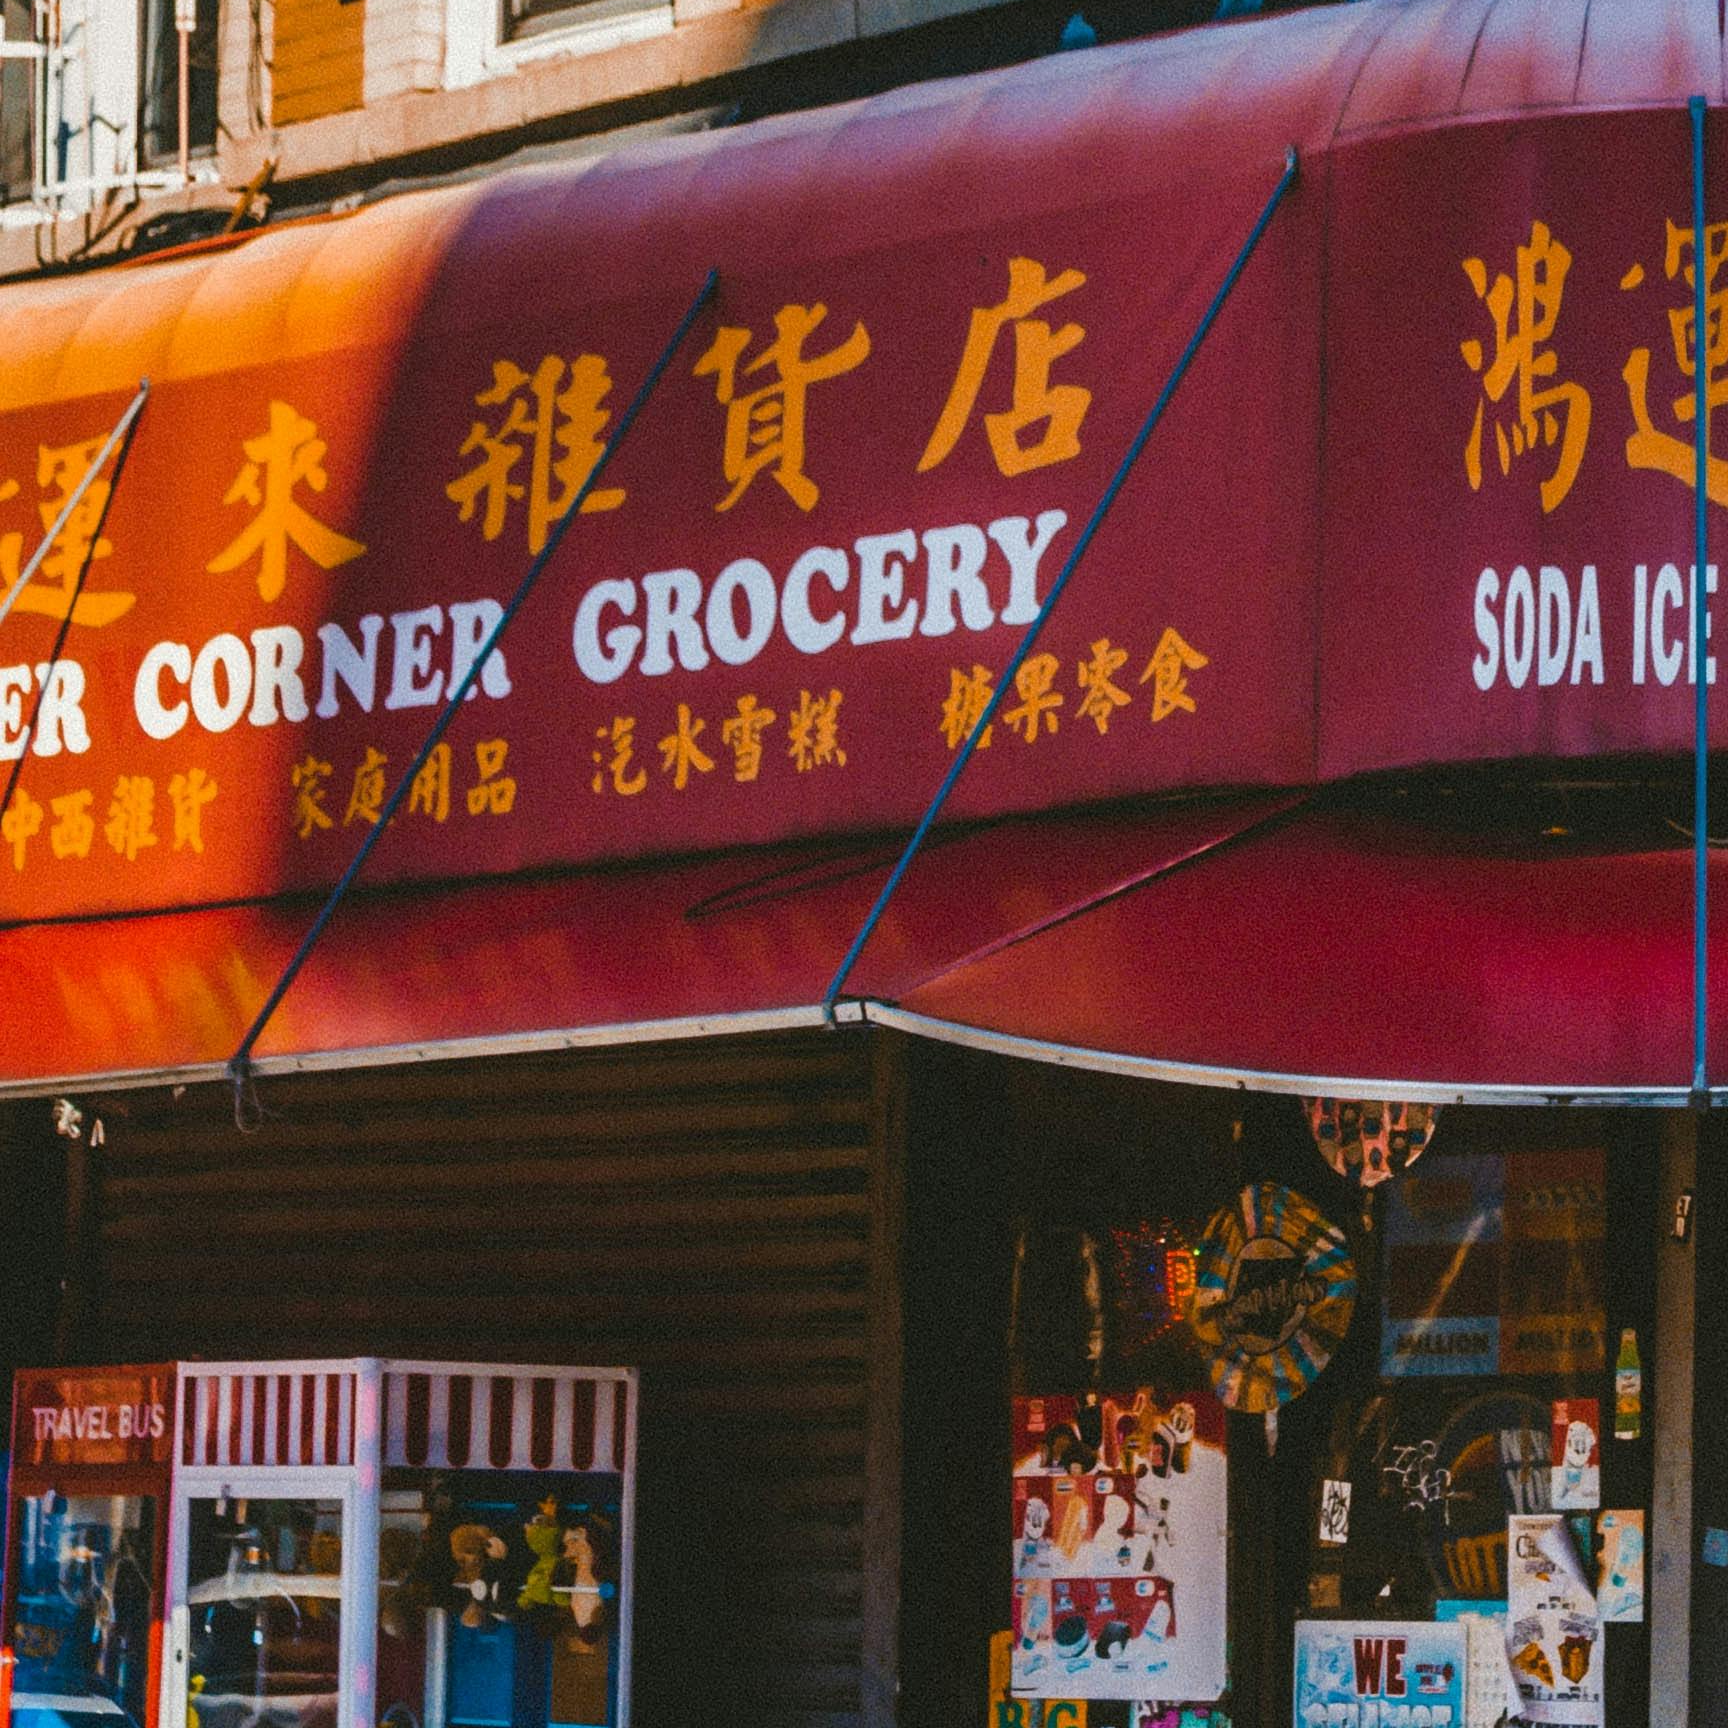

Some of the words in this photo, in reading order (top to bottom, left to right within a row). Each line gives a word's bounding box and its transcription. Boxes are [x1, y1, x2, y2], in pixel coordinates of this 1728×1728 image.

[133, 598, 512, 740] CORNER
[572, 508, 1068, 684] GROCERY
[1471, 564, 1604, 691] SODA
[1632, 562, 1719, 686] ICE
[32, 1405, 113, 1440] TRAVEL
[118, 1403, 165, 1439] BUS
[1354, 1638, 1407, 1696] WE
